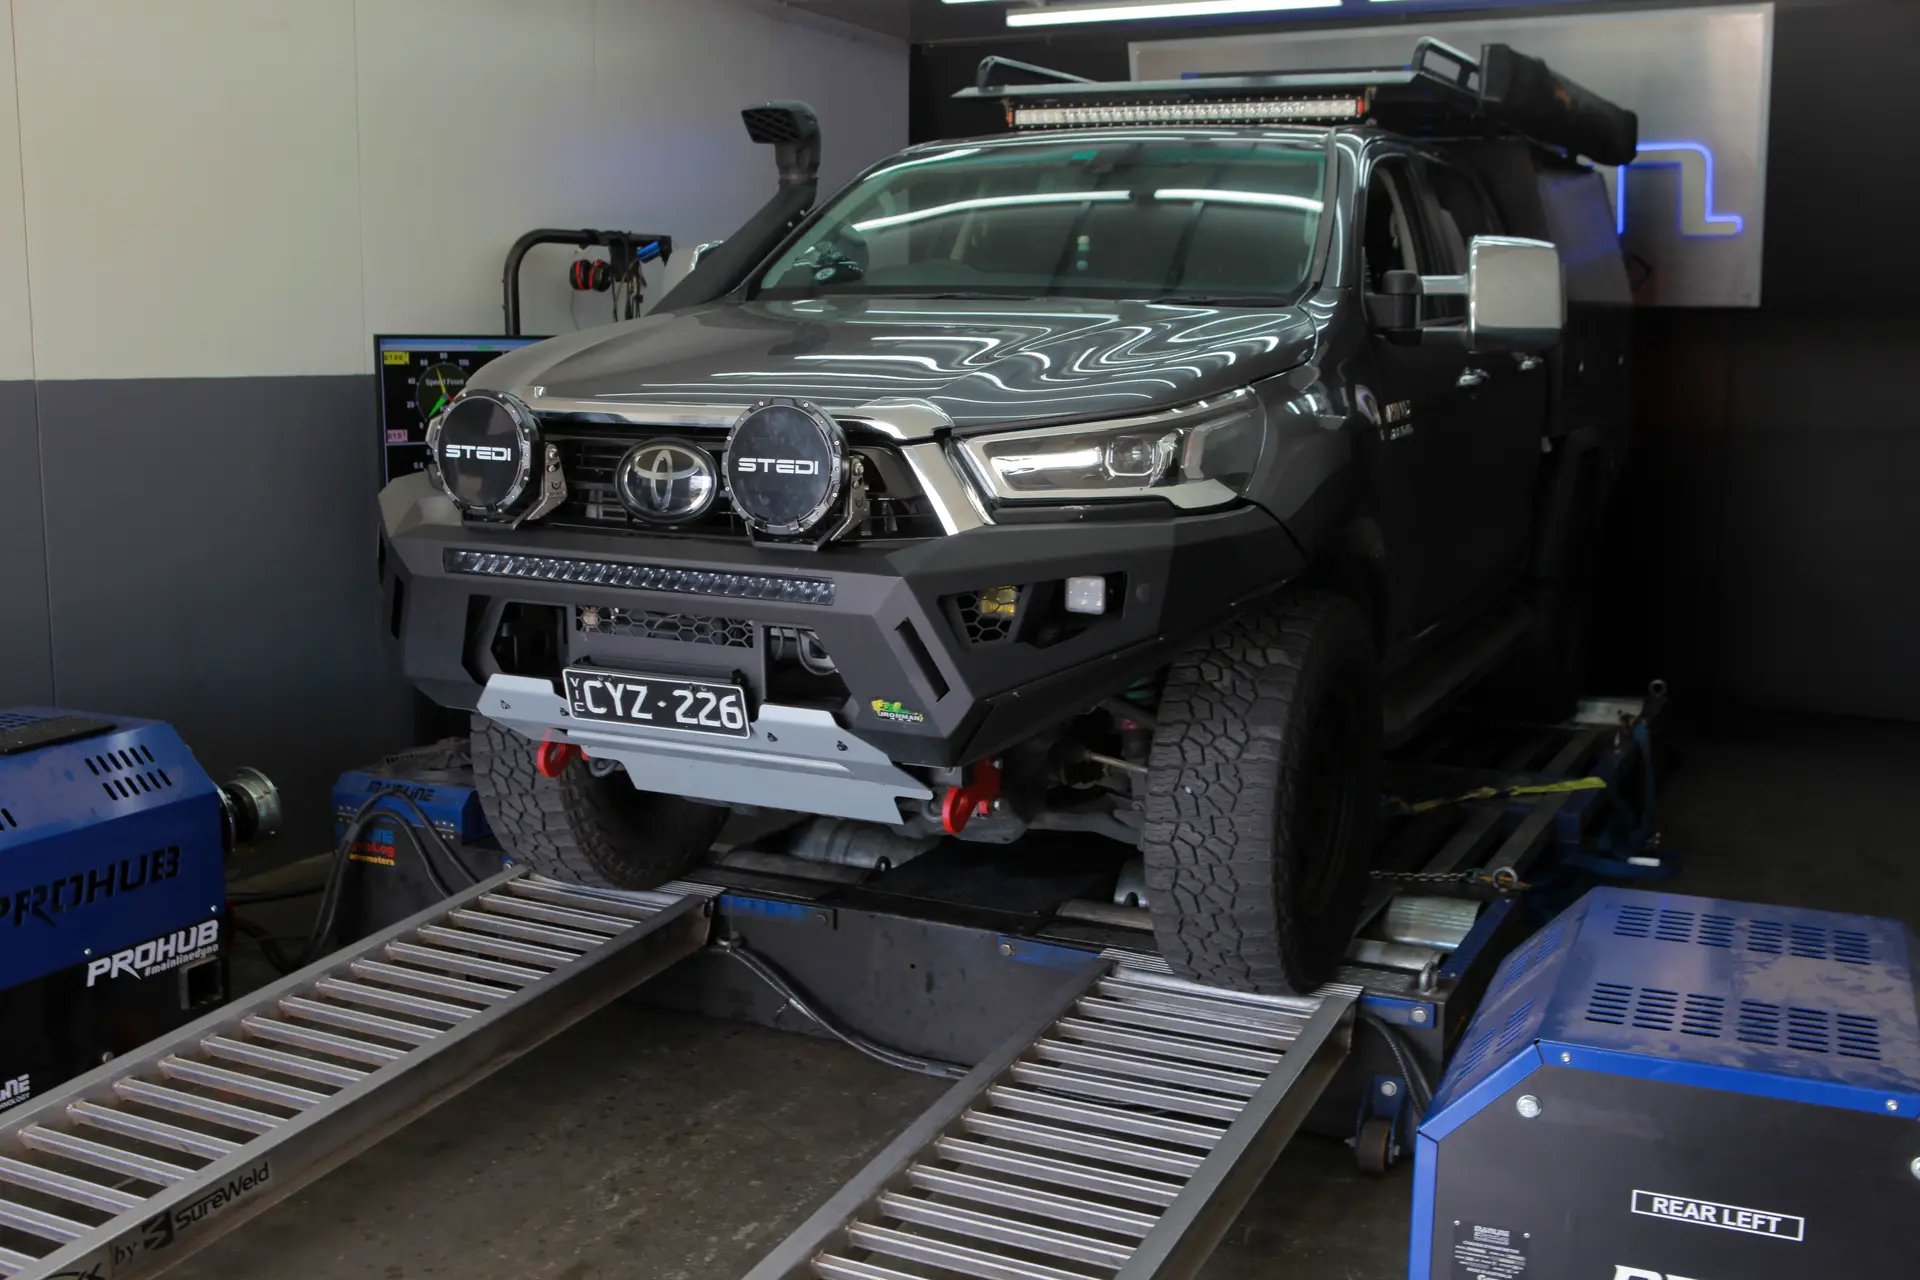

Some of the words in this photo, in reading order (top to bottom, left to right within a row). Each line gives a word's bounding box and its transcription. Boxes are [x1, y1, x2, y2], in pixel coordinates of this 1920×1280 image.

[446, 444, 512, 462] STEDI
[738, 457, 819, 475] STEDI
[86, 919, 219, 987] PROHUB
[174, 1161, 270, 1232] SureWeld
[1651, 1197, 1717, 1224] REAR
[1722, 1208, 1783, 1233] LEFT
